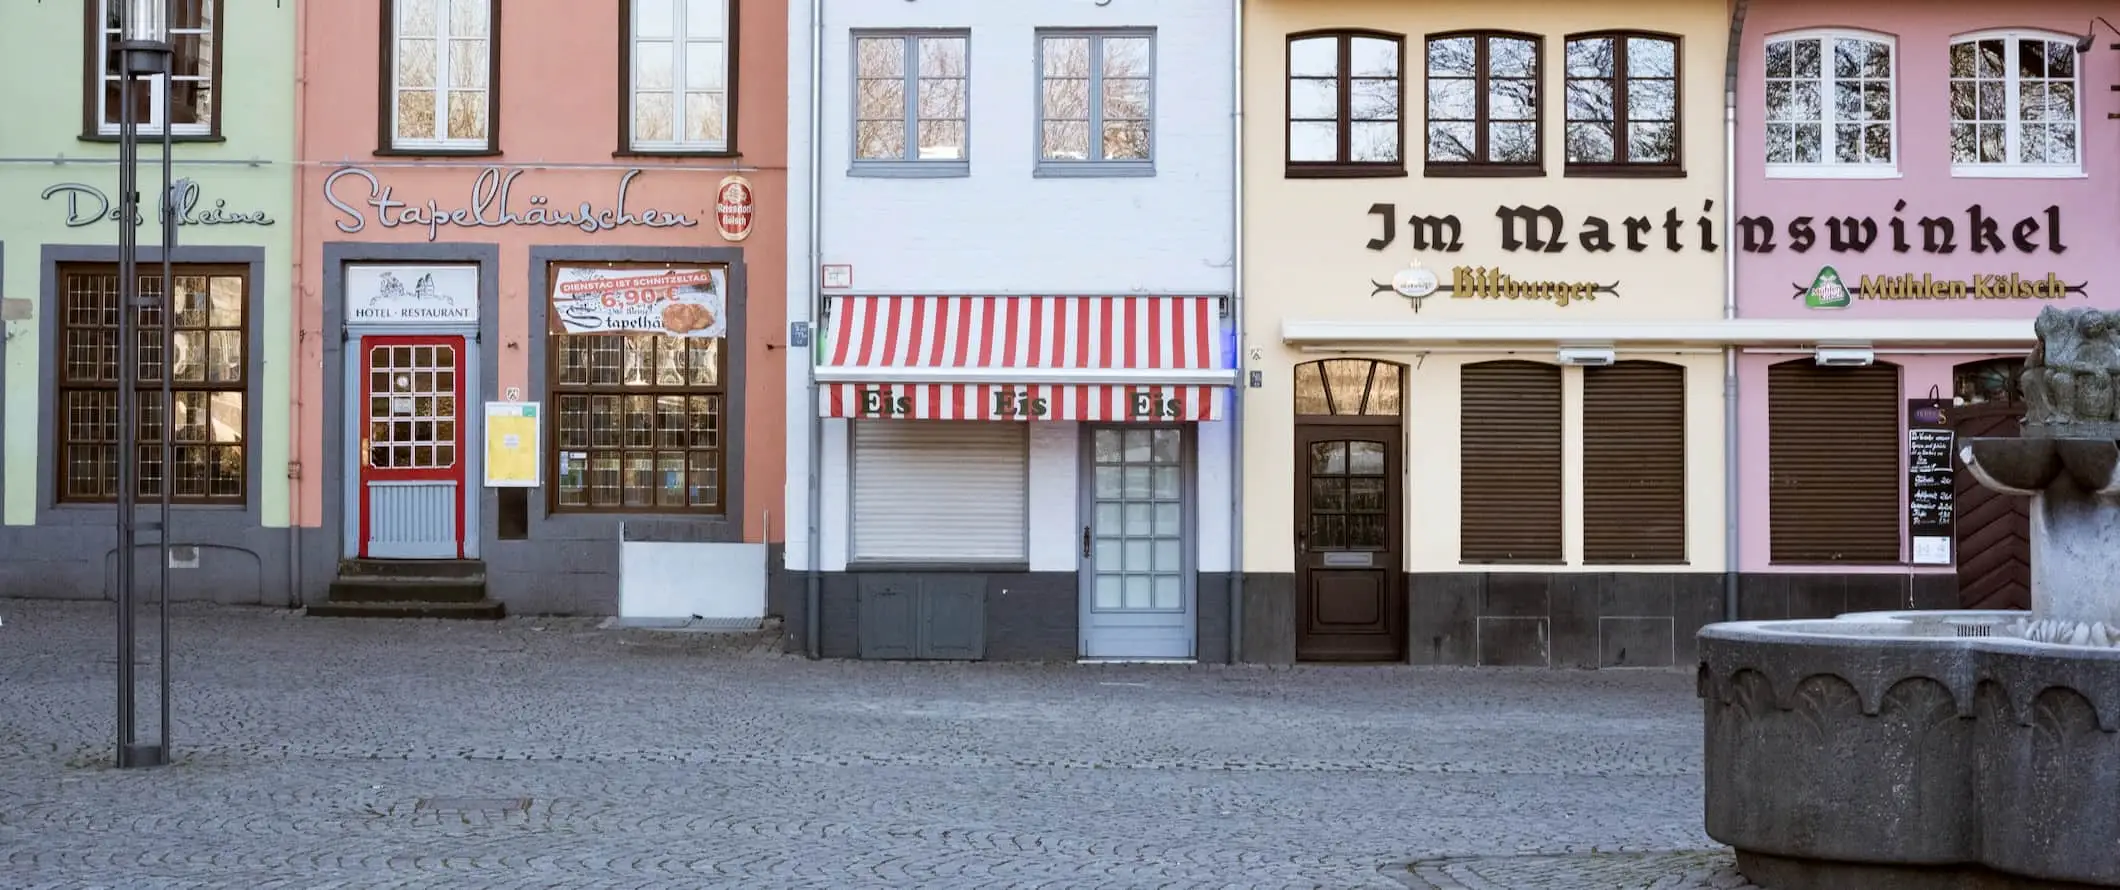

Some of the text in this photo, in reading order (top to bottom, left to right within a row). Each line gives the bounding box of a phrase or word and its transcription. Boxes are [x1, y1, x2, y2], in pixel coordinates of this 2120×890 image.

[323, 166, 698, 241] Stapelhäuschen
[1365, 198, 2067, 254] Im Martinswinkel
[563, 274, 708, 292] DIENSTAG IST SCHNITZELTAG
[1451, 265, 1599, 308] Bitburger
[1858, 271, 2067, 300] Mühlen Kölsch
[601, 286, 681, 309] 6,90 €
[356, 308, 469, 318] HOTEL RESTAURANT
[562, 305, 665, 330] Stapelhä
[858, 389, 913, 416] Eis
[993, 390, 1047, 417] Eis
[1129, 391, 1182, 418] Eis
